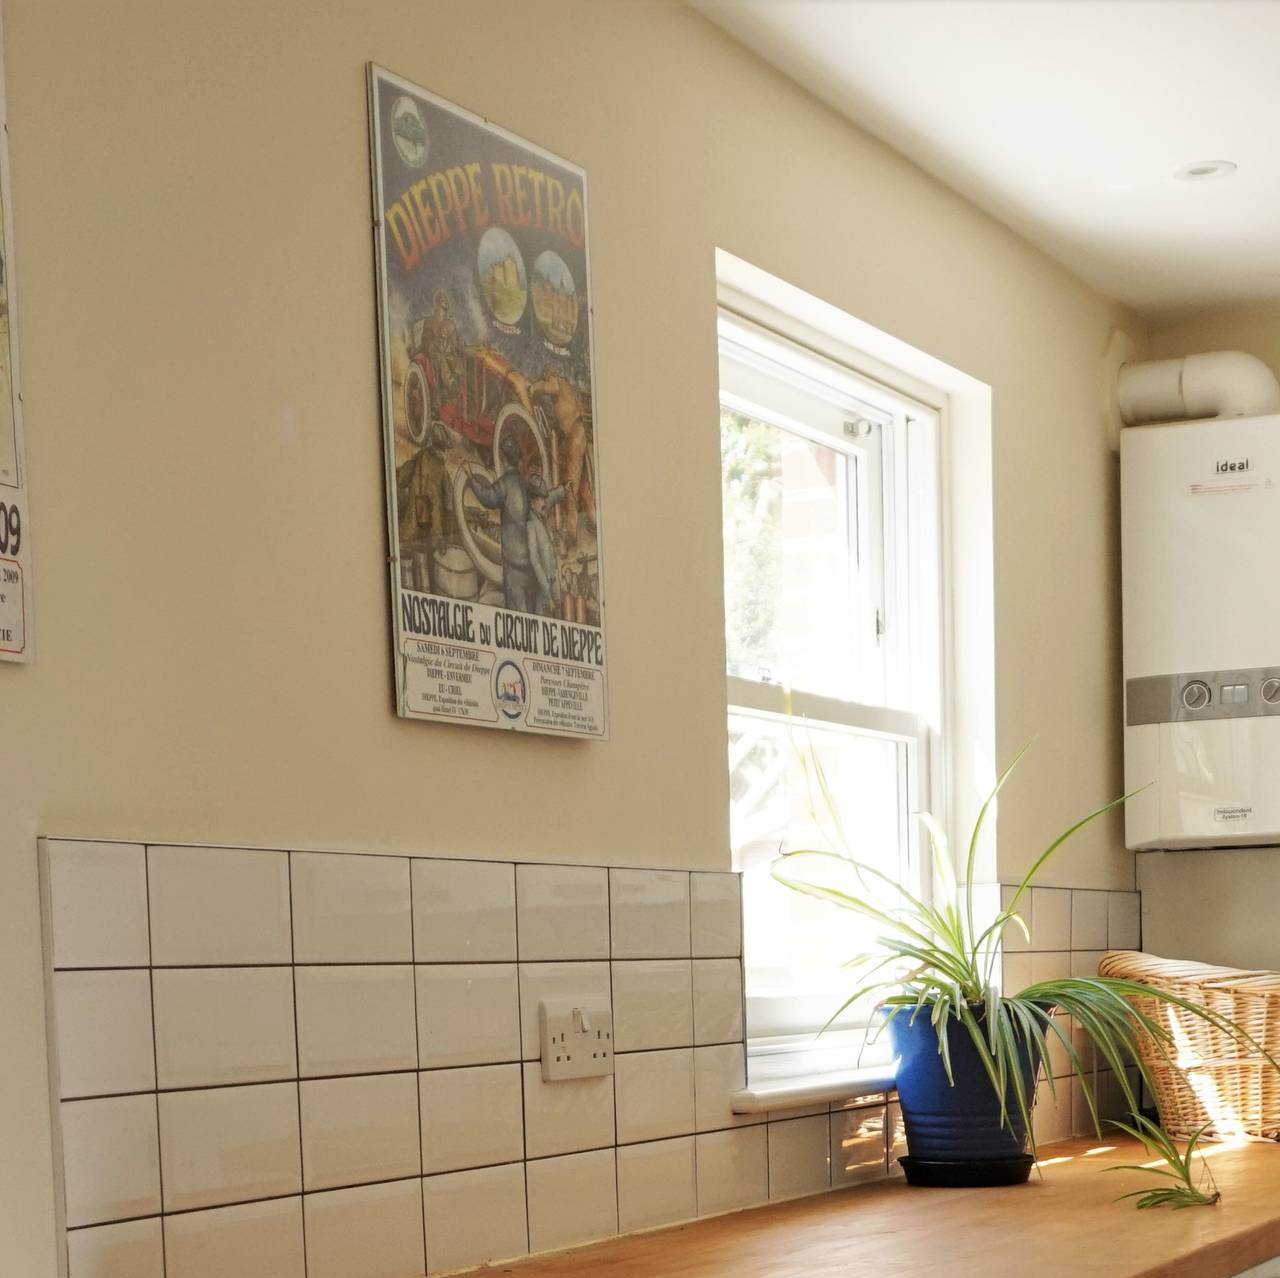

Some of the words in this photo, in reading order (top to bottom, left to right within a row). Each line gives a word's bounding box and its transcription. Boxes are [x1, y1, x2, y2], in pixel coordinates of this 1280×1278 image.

[385, 162, 489, 272] DIEPPE
[491, 162, 585, 247] RETRO
[1216, 458, 1249, 473] ideal
[3, 568, 19, 584] 2009
[401, 593, 475, 643] NOSTALGIE
[480, 622, 491, 647] DU
[494, 611, 539, 654] CIRCUIT
[542, 621, 559, 658] DE
[560, 624, 604, 666] DIEPPE
[417, 643, 440, 656] SAMEDI
[445, 646, 479, 662] SEPTEMBRE
[532, 662, 560, 675] DIMANCHE
